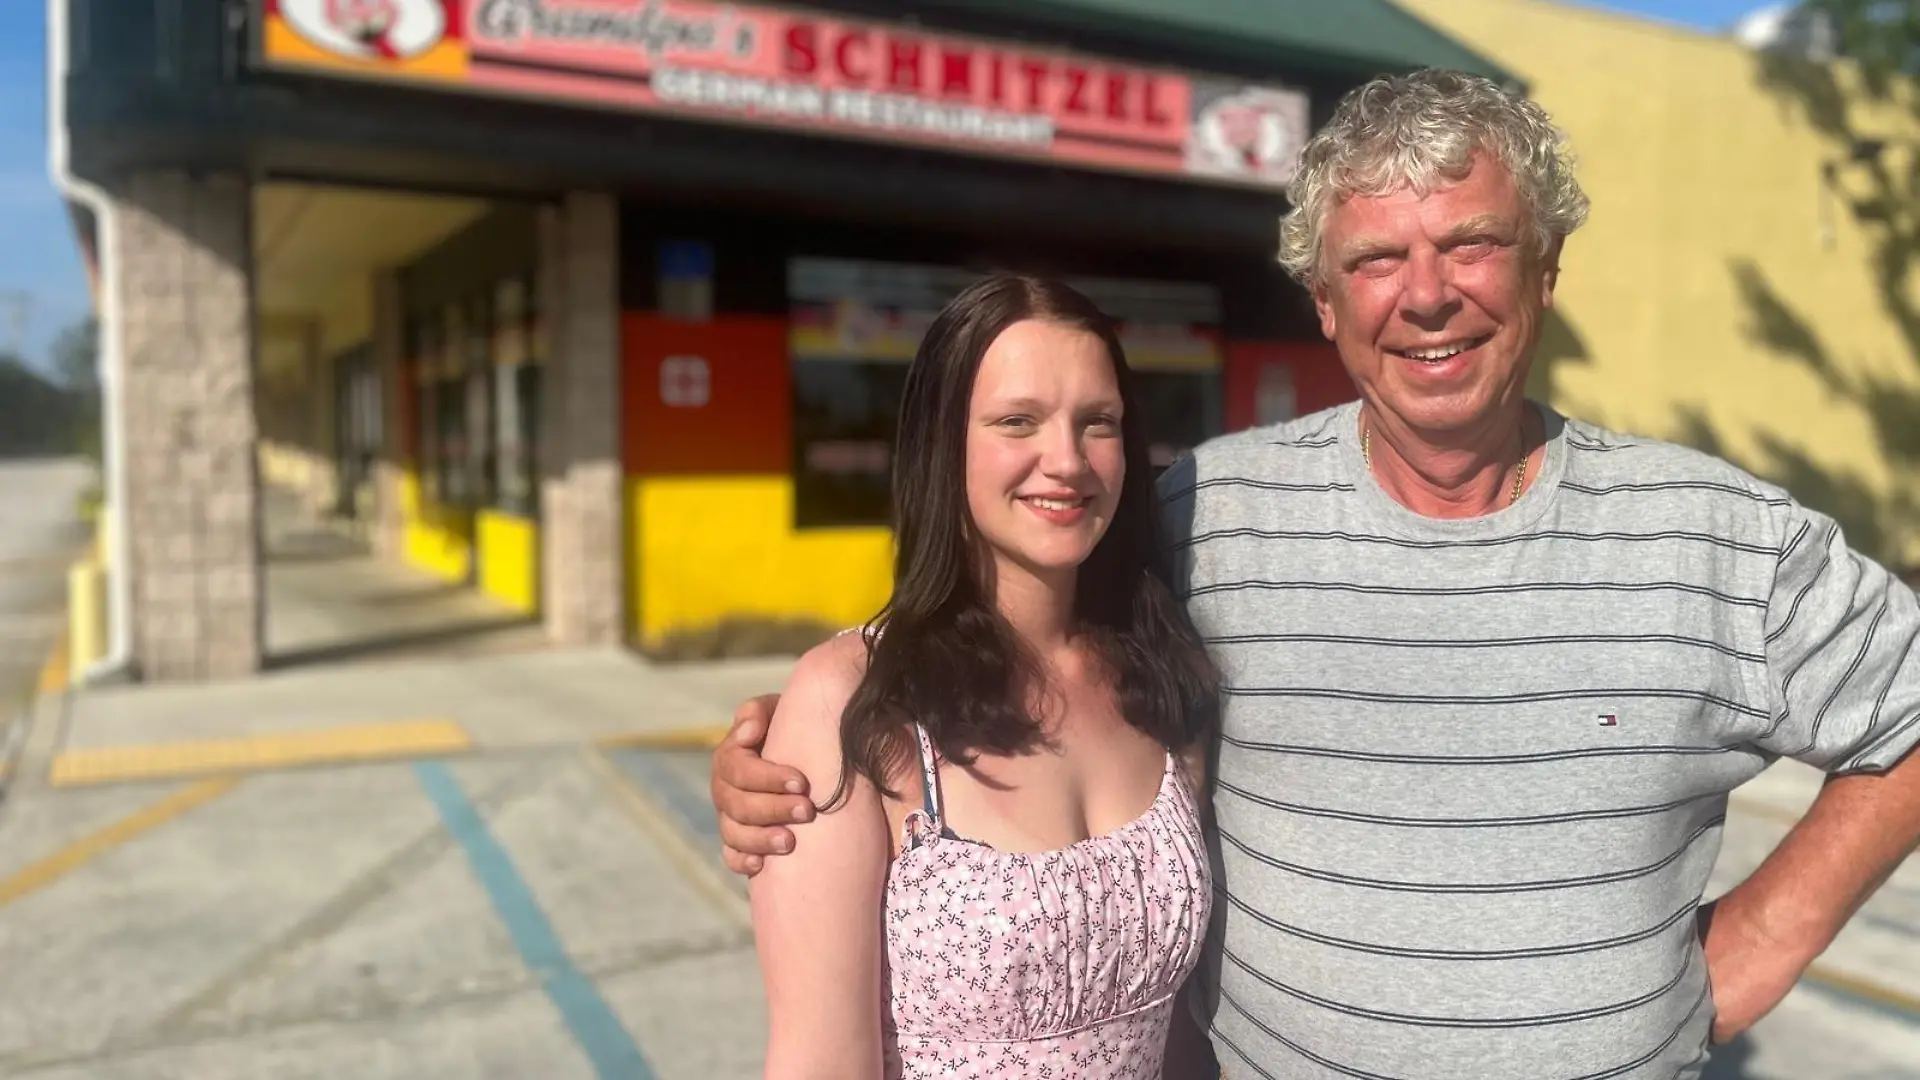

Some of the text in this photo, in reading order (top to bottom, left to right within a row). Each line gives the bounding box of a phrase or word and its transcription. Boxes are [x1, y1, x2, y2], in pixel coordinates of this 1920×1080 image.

[653, 66, 1054, 145] GERMAN RESTAURANT
[782, 22, 1174, 128] SCHNITZEL
